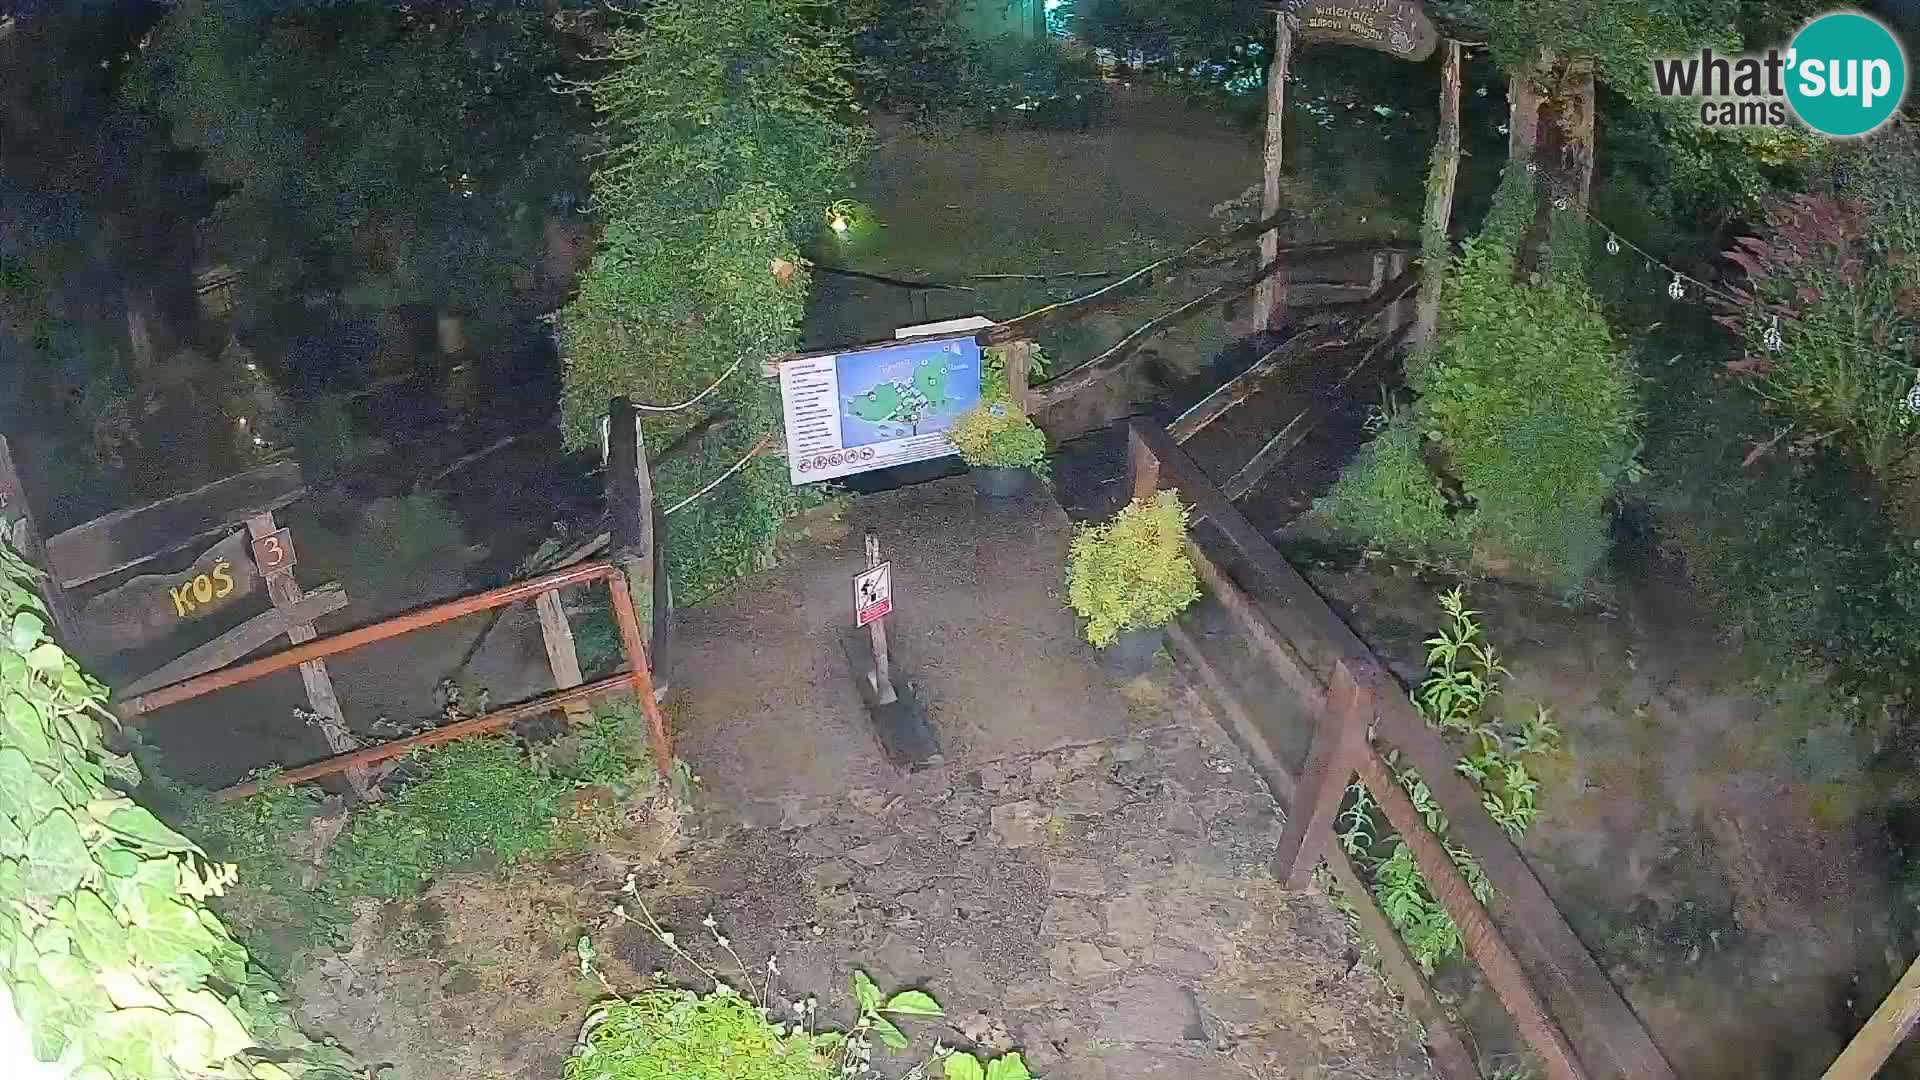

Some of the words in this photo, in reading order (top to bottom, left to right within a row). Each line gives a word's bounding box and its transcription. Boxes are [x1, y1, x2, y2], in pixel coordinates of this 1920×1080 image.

[1315, 4, 1374, 27] waterfalls
[263, 537, 284, 567] 3
[169, 557, 235, 618] KOŠ
